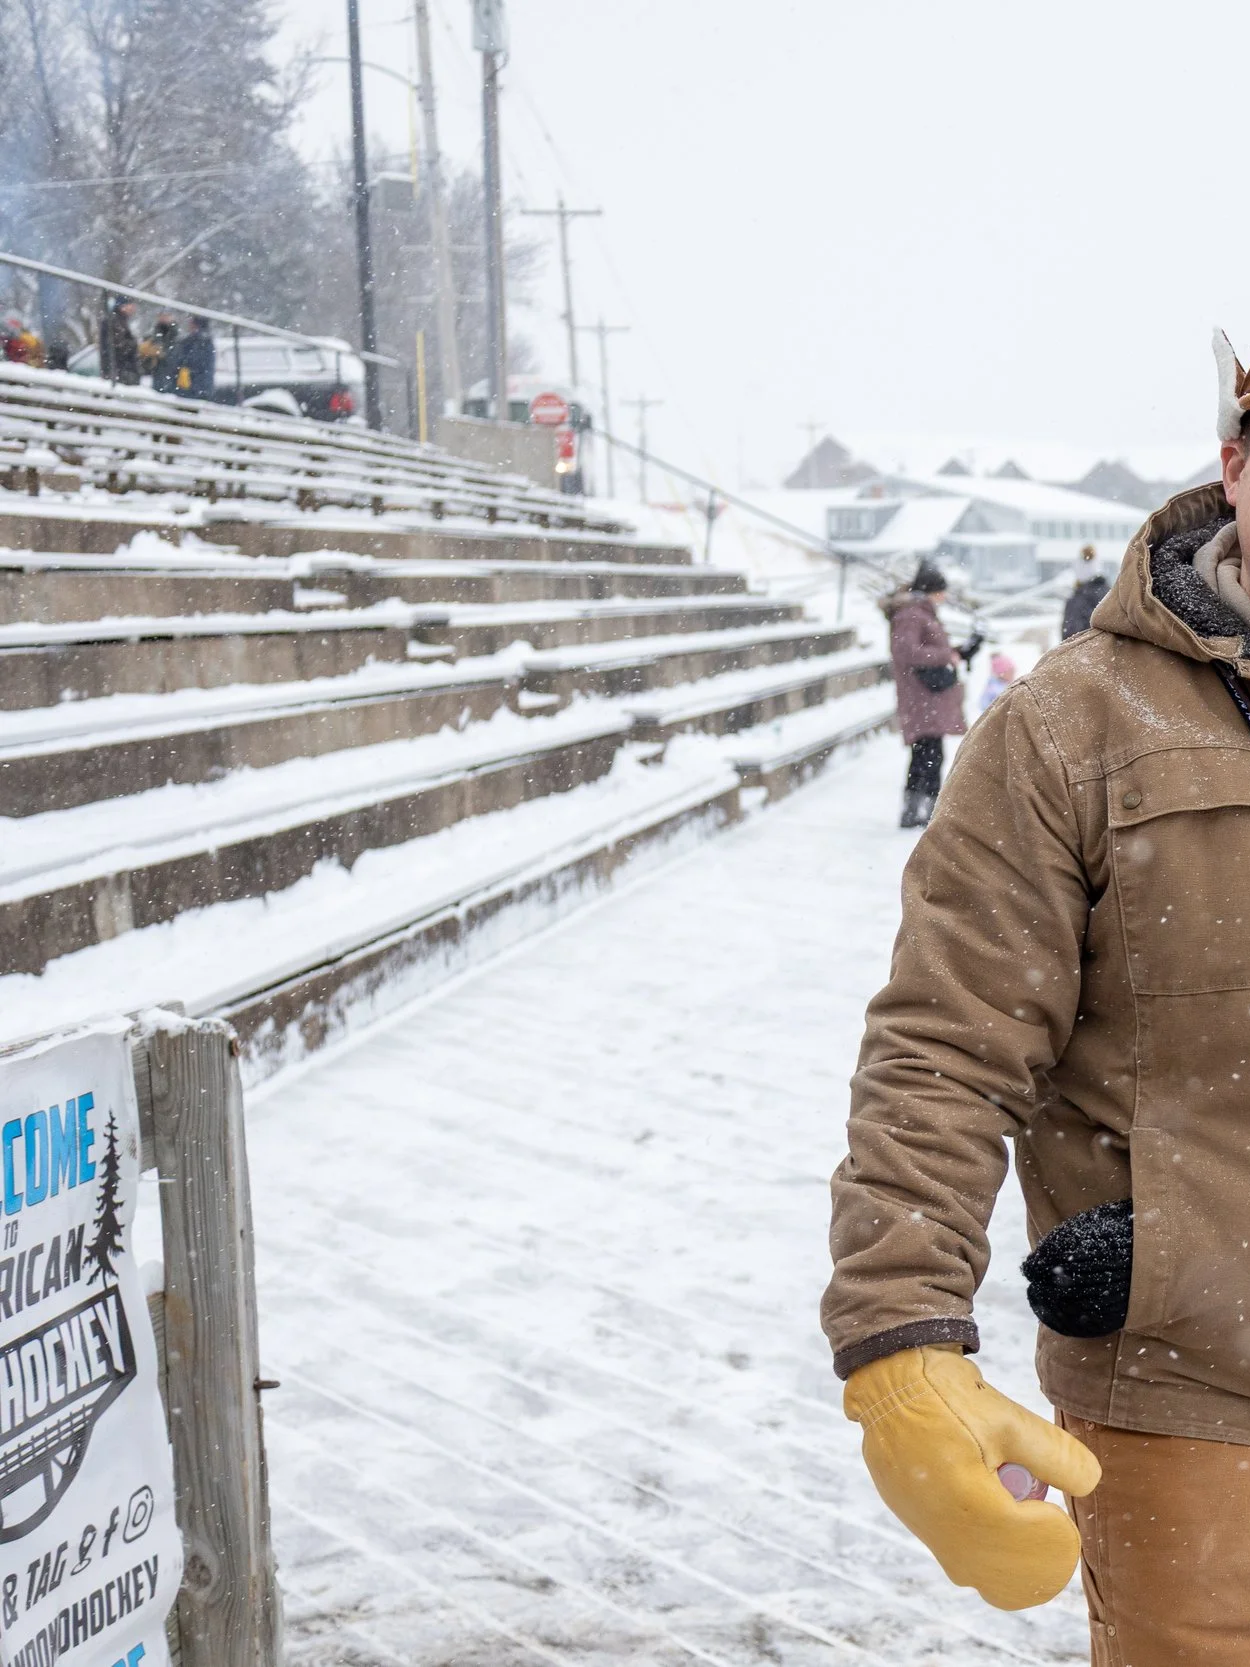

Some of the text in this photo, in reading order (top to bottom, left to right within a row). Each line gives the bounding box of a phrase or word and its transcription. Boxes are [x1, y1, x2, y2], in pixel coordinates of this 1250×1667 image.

[0, 1091, 96, 1217] COME
[0, 1294, 125, 1434] HOCKEY
[2, 1573, 18, 1630] &
[25, 1540, 68, 1612] TAG
